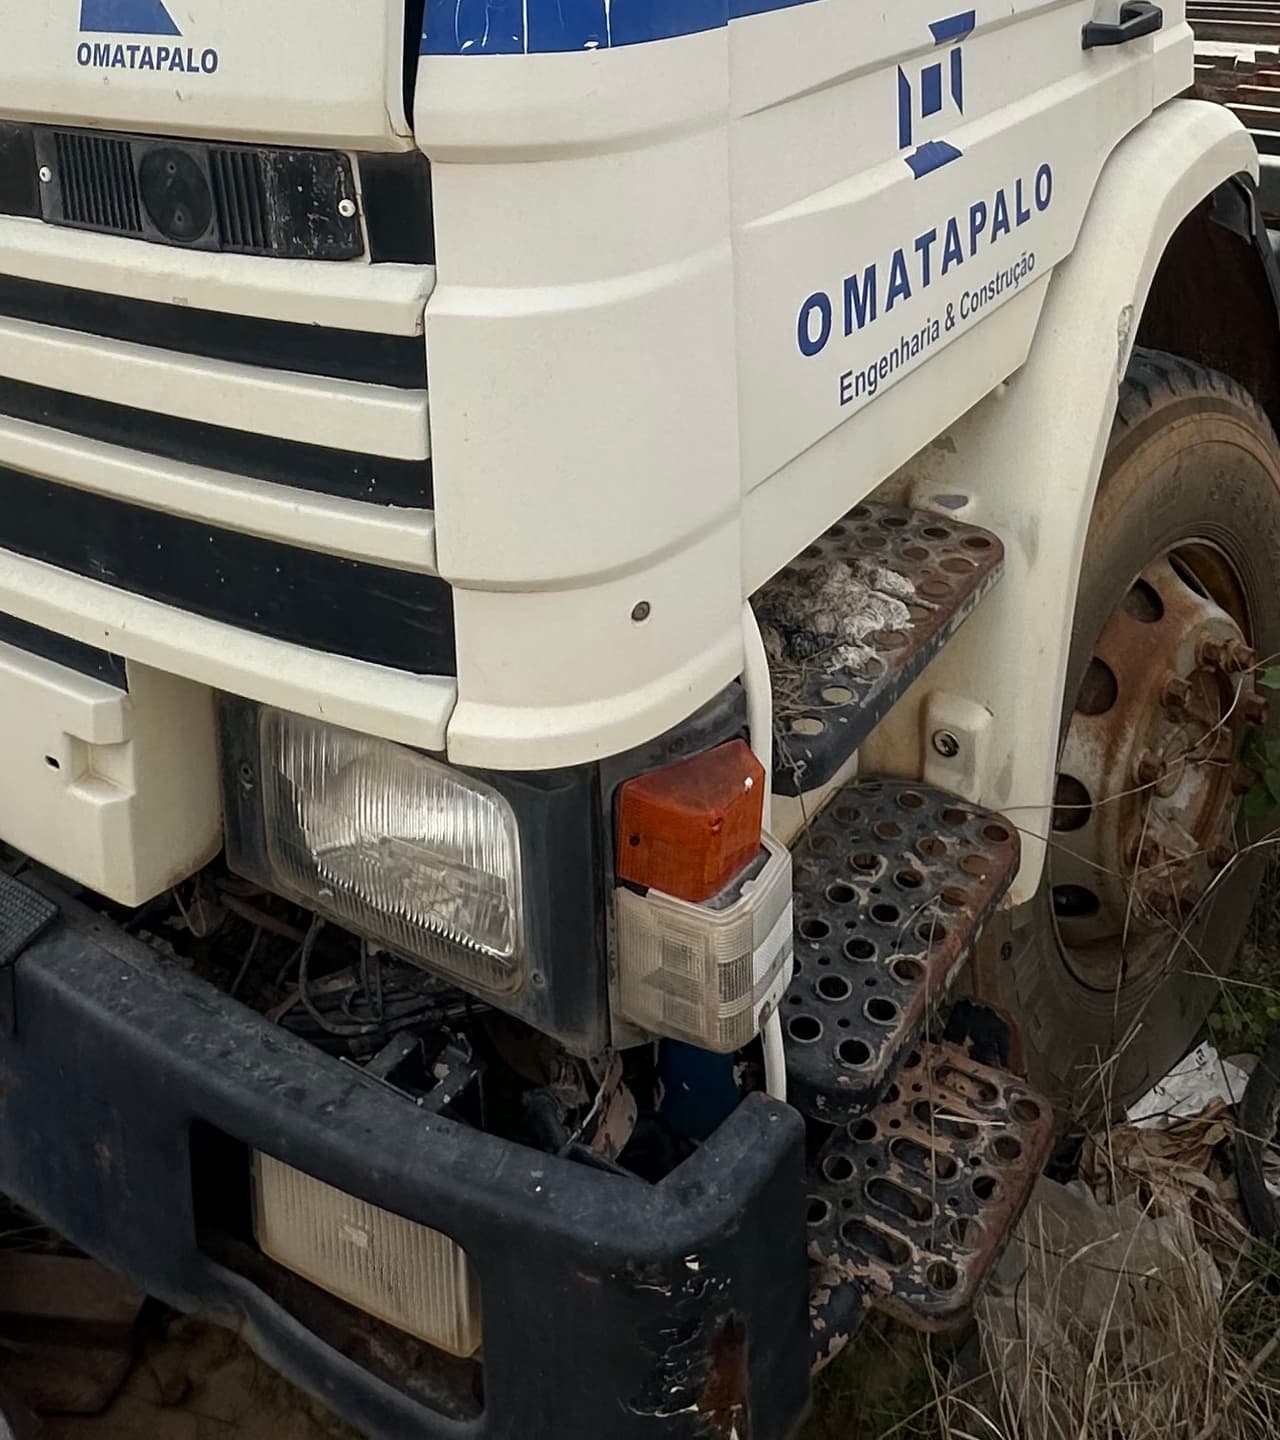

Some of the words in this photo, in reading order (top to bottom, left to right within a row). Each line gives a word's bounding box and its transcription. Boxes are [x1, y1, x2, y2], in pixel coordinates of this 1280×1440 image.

[76, 42, 219, 74] OMATAPALO
[795, 163, 1054, 358] OMATAPALO
[839, 315, 941, 407] Engenharia
[944, 302, 956, 332] &
[959, 251, 1036, 321] Construção
